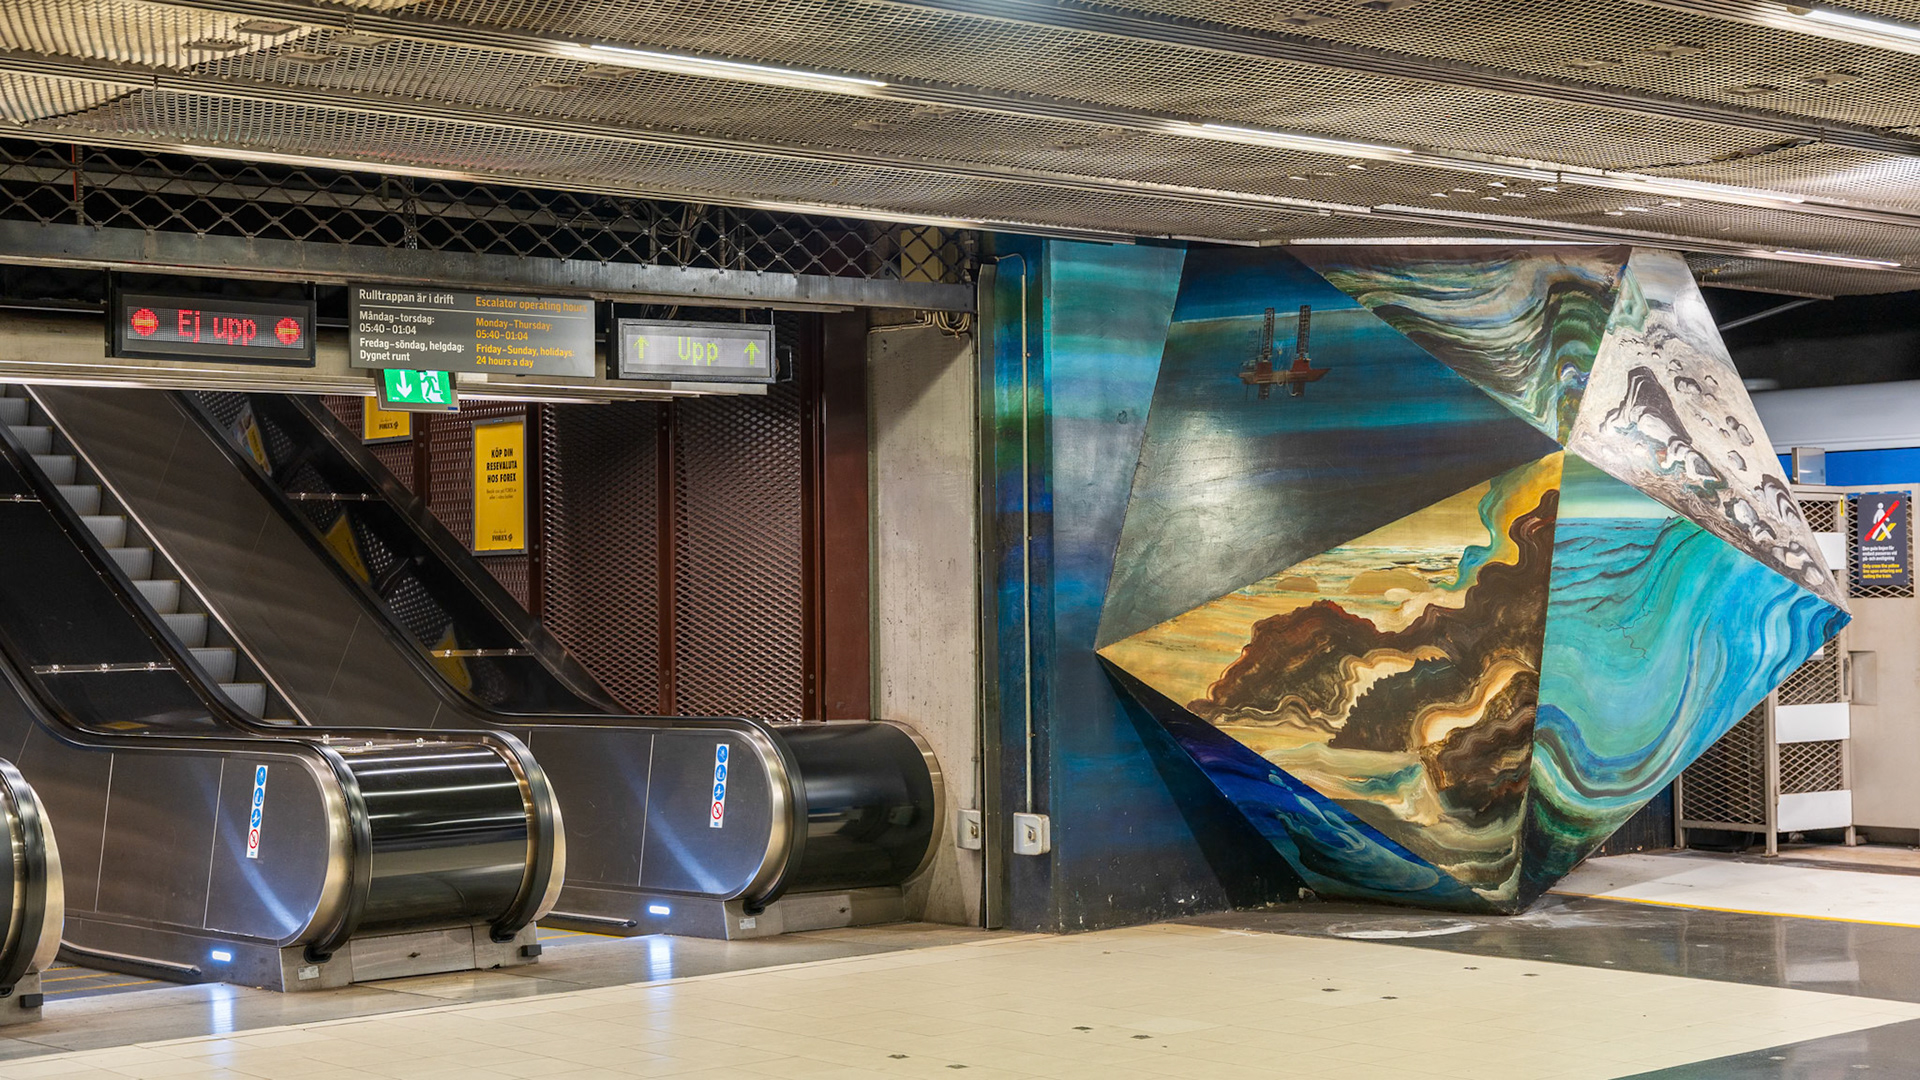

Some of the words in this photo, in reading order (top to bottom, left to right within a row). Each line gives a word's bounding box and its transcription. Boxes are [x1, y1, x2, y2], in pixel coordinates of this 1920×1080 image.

[359, 289, 414, 303] Rulltrappan
[417, 293, 426, 302] är
[434, 294, 454, 304] drift
[476, 296, 517, 308] Escalator
[520, 300, 560, 312] operating
[563, 302, 588, 312] hours
[178, 309, 200, 343] Ej
[213, 317, 256, 346] upp
[430, 341, 464, 353] helgdag:
[540, 347, 574, 358] holidays:
[678, 336, 718, 366] Upp
[360, 350, 390, 361] Dygnet
[392, 353, 410, 361] runt
[476, 356, 486, 364] 24
[488, 357, 511, 366] hours
[520, 358, 534, 368] day
[491, 447, 502, 458] KÖP
[504, 448, 513, 457] DIN
[486, 460, 517, 471] RESEVALUTA
[487, 474, 498, 483] HOS
[500, 473, 516, 482] FOREX
